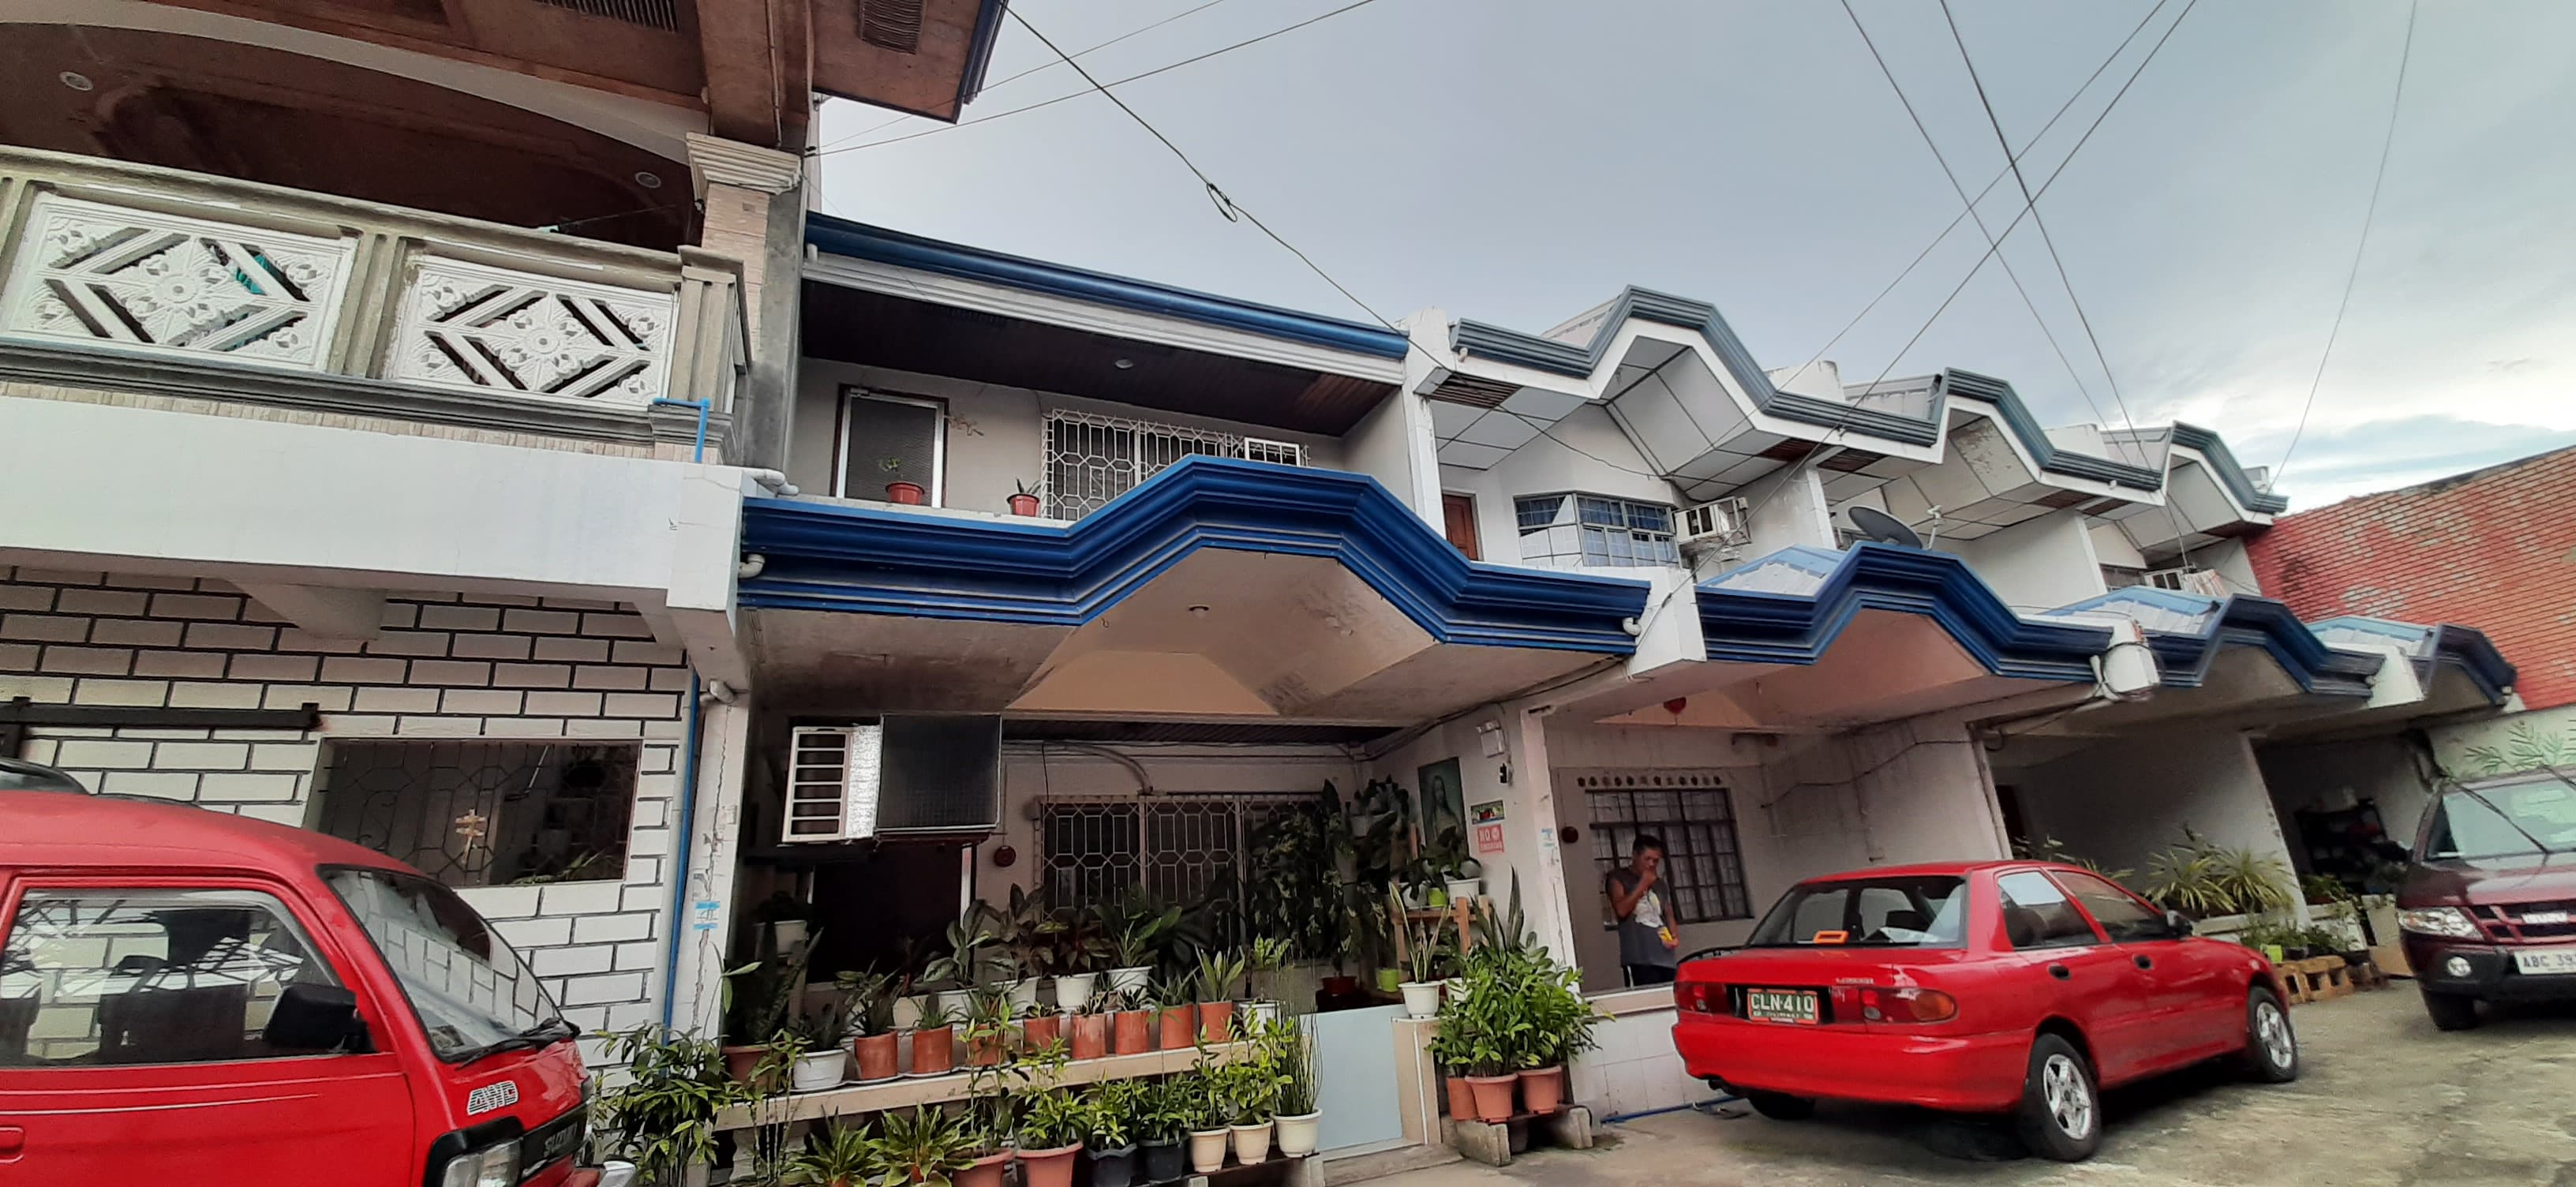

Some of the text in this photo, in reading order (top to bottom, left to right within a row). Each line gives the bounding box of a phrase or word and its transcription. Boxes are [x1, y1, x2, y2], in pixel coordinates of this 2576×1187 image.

[1479, 829, 1491, 841] NO
[2523, 953, 2576, 968] ABC 39
[467, 1080, 519, 1116] 4WD
